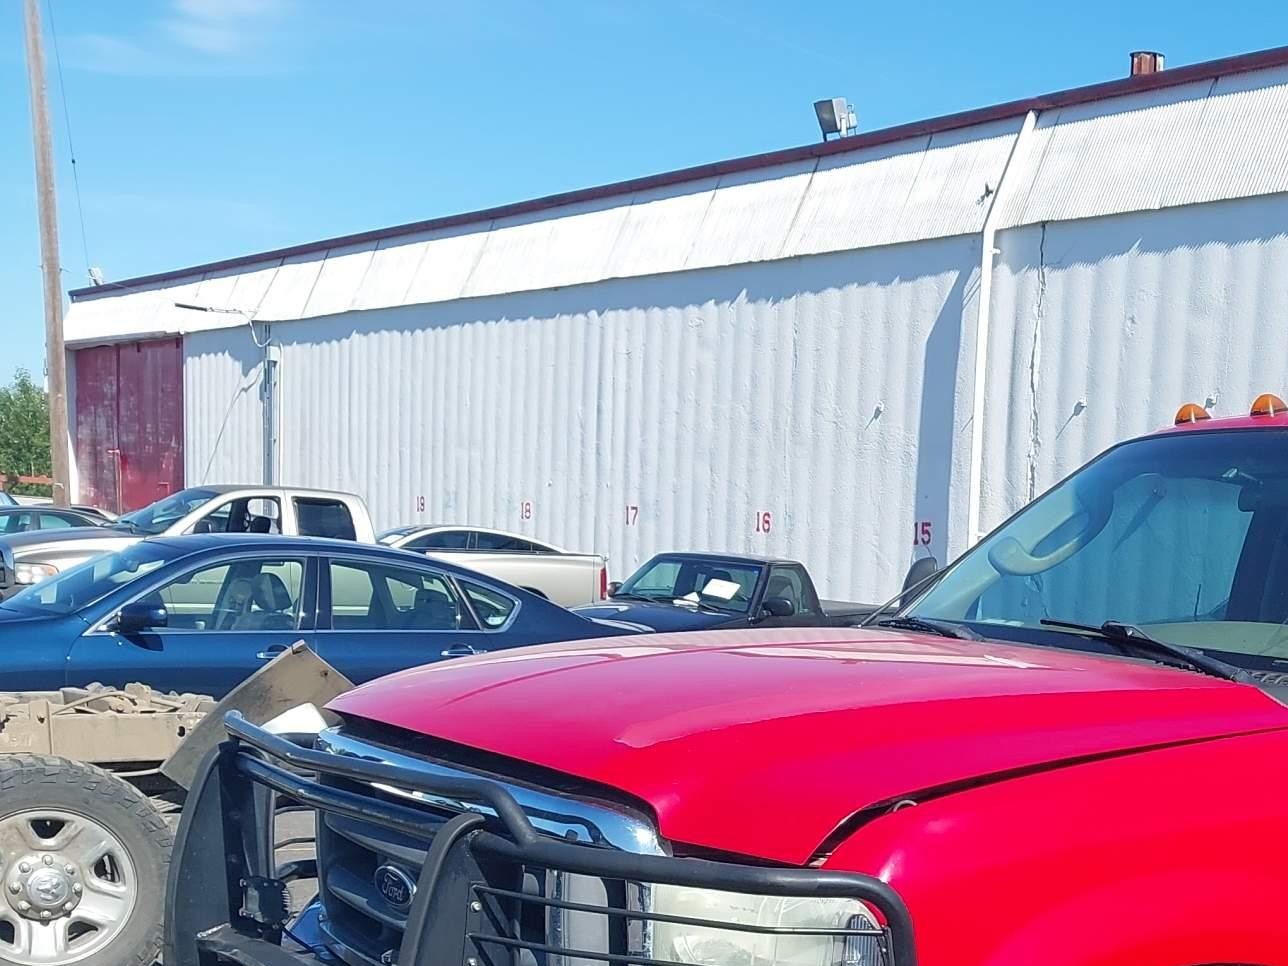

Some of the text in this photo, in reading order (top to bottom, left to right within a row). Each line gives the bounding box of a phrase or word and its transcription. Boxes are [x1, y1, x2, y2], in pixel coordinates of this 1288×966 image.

[416, 496, 425, 512] 19
[521, 502, 531, 519] 18
[625, 505, 639, 526] 17
[756, 511, 771, 533] 16
[913, 521, 932, 546] 15
[381, 871, 405, 902] Ford
